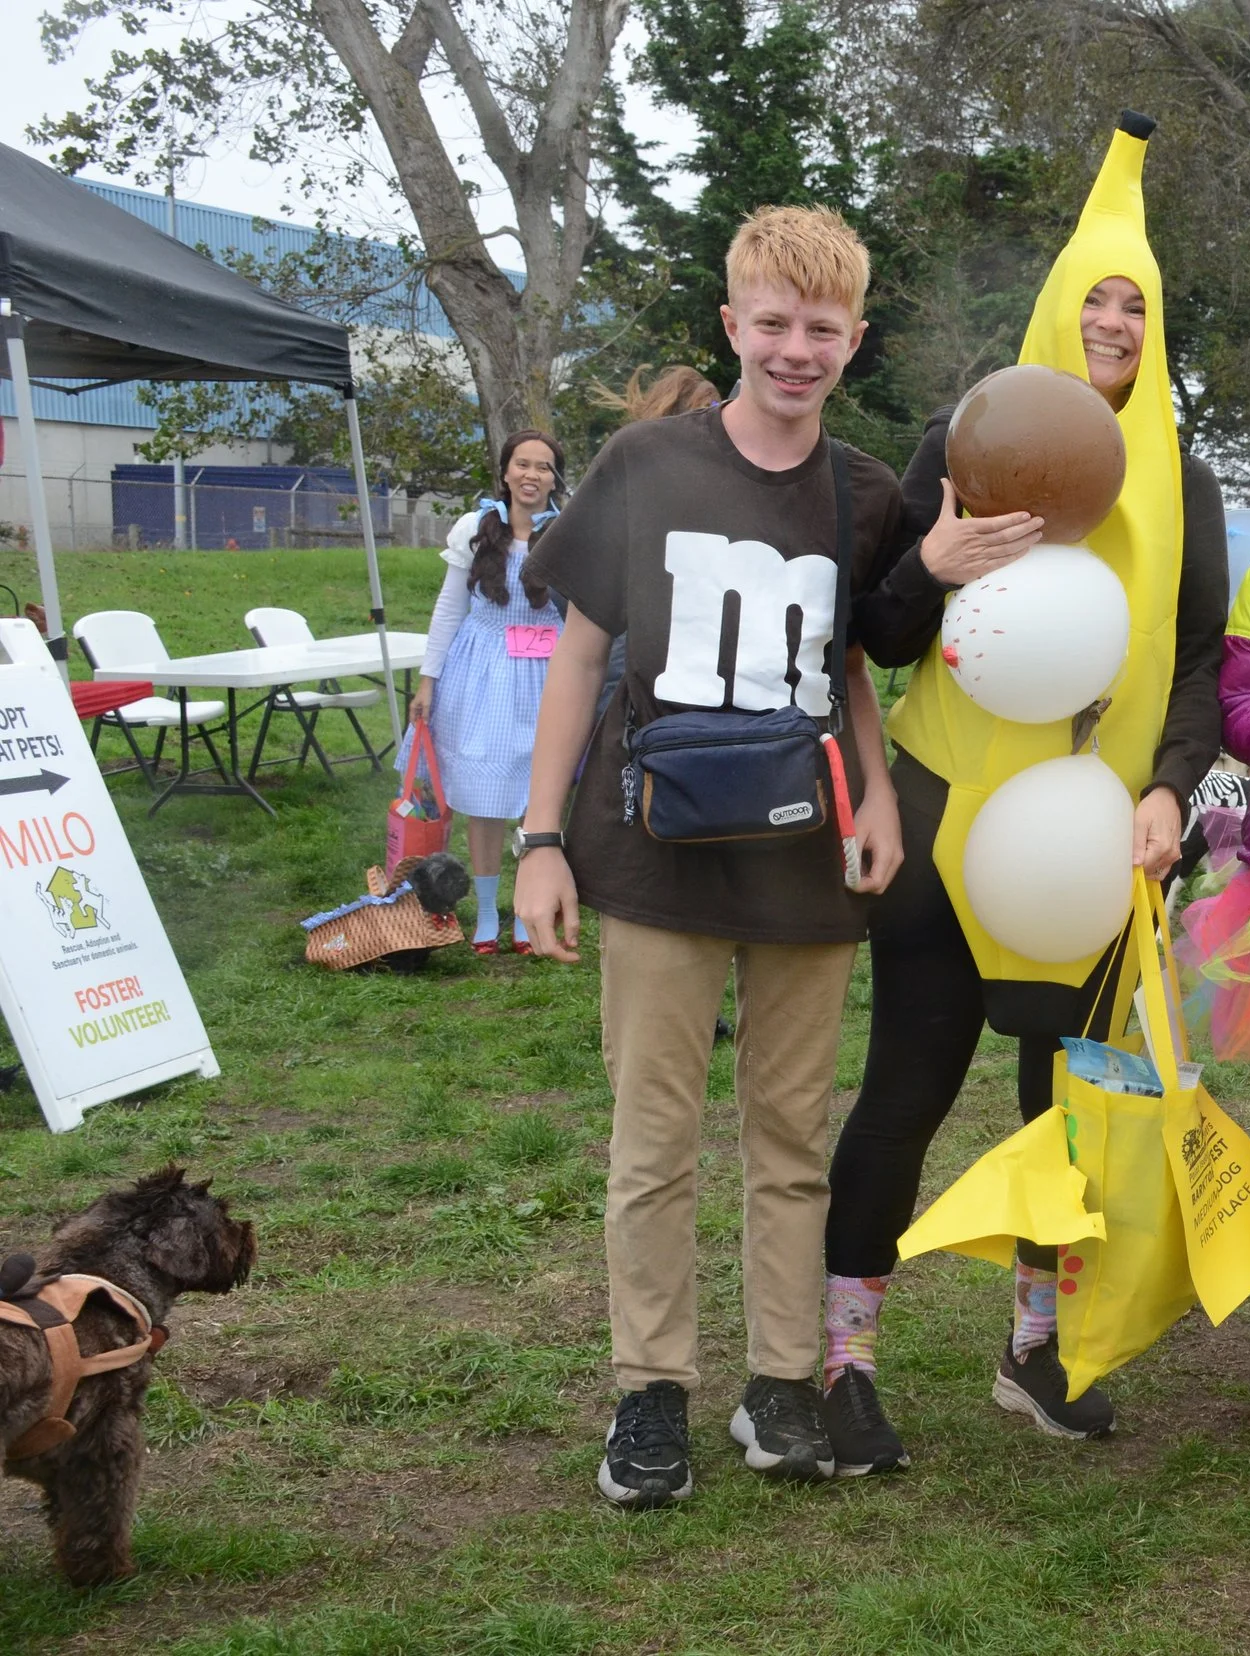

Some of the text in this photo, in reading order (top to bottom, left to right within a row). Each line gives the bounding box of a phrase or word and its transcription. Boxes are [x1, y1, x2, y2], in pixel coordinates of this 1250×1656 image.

[508, 626, 554, 654] 125
[16, 735, 64, 760] PETS!
[773, 806, 810, 821] OUTDOOR
[0, 811, 95, 869] MILO
[85, 936, 110, 948] Adoption
[110, 932, 121, 942] and
[52, 957, 82, 970] Sanctuary
[81, 954, 90, 962] for
[91, 948, 116, 960] domestic
[74, 975, 144, 1013] FOSTER!
[68, 999, 171, 1048] VOLUNTEER!
[1200, 1216, 1218, 1248] FIRST
